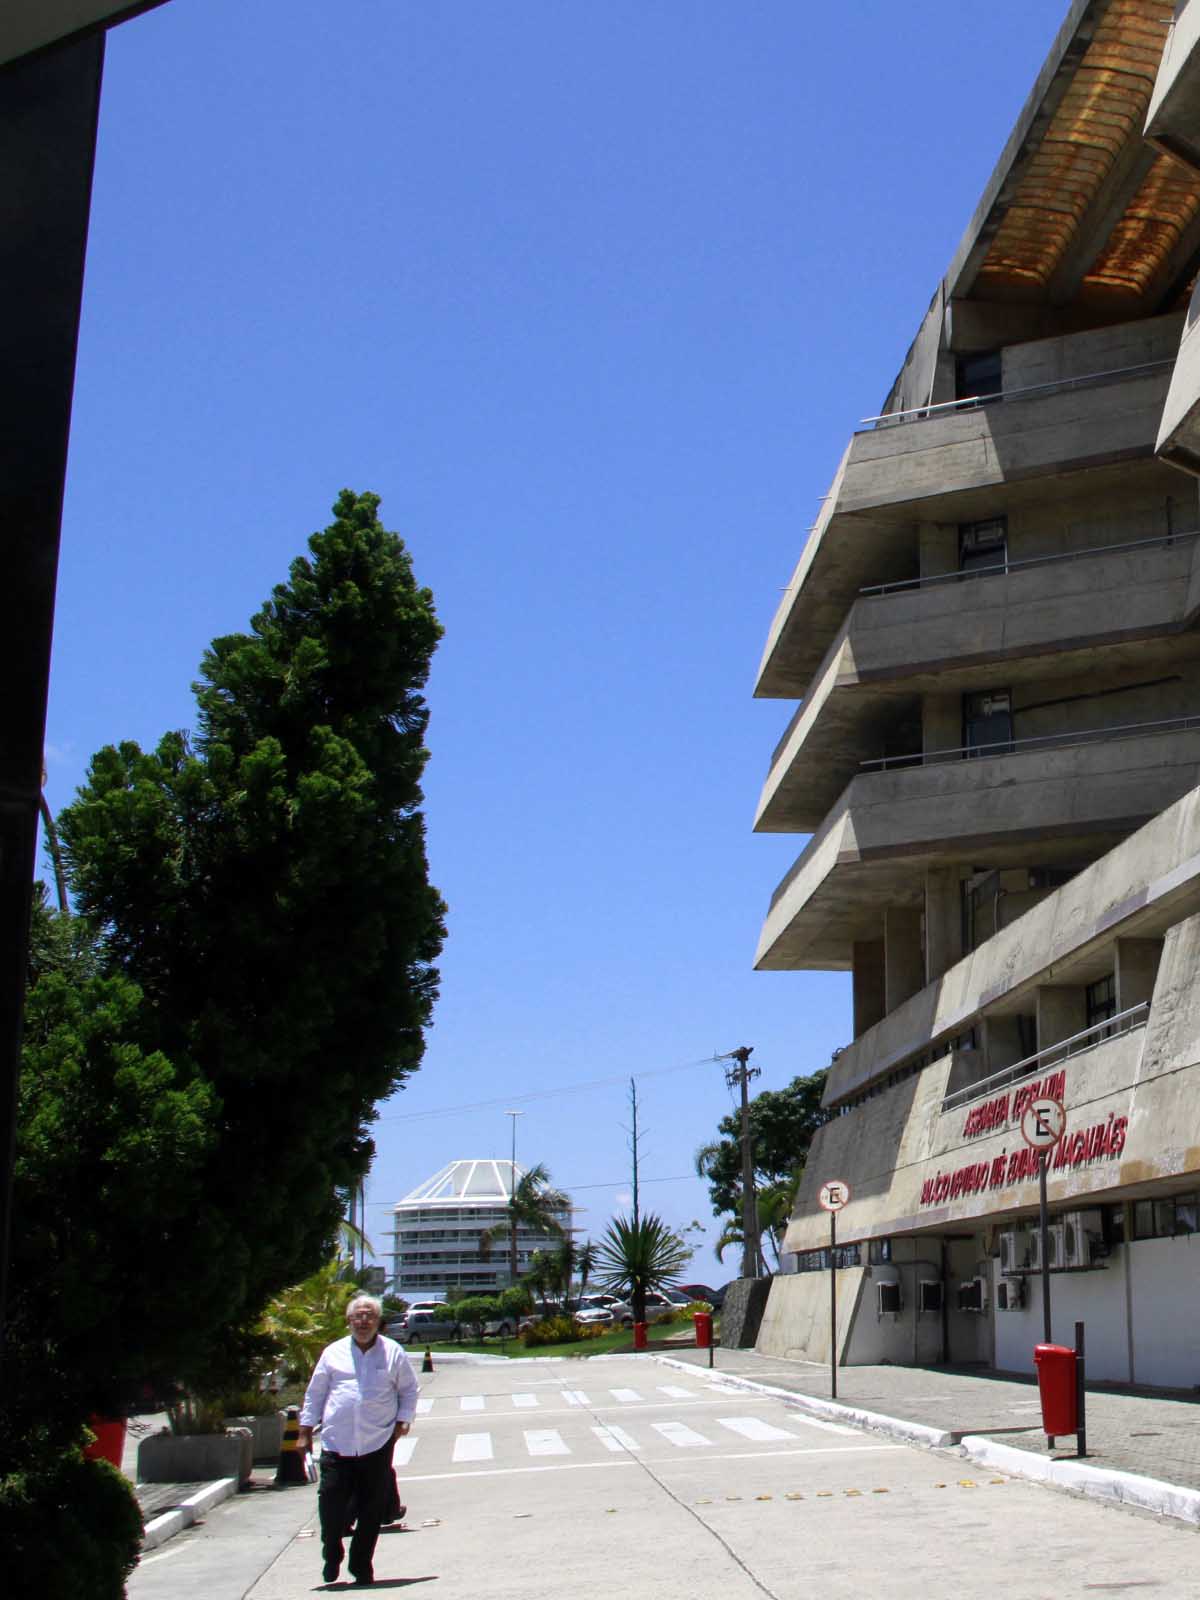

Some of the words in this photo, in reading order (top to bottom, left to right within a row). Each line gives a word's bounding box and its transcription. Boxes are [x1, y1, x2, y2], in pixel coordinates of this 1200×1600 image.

[1036, 1109, 1050, 1136] E
[1006, 1147, 1053, 1185] EDUARO
[830, 1187, 840, 1203] E
